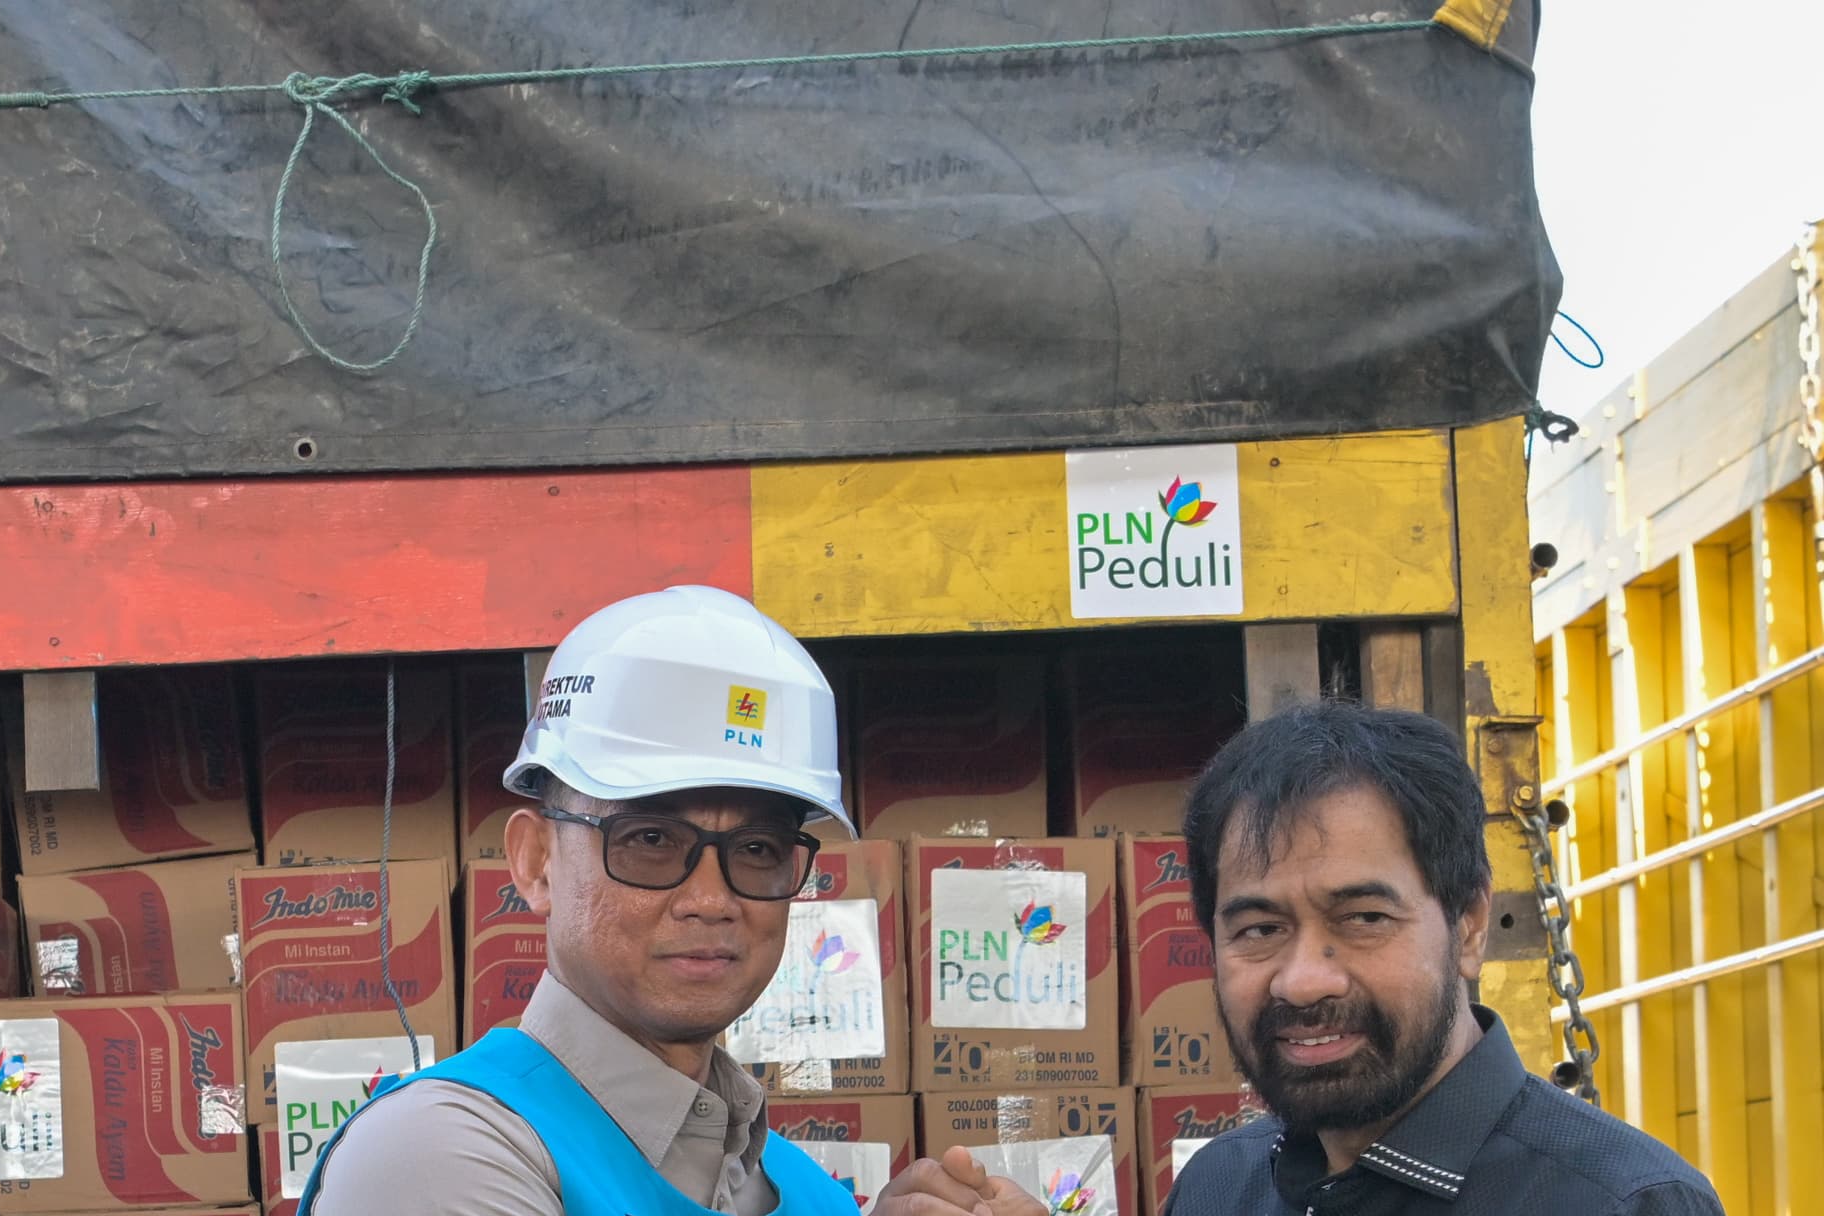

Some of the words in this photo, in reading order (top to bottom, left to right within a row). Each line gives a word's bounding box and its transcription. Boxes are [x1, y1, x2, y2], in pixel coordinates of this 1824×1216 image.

[1077, 512, 1152, 545] PLN
[1078, 541, 1231, 589] Peduli
[725, 729, 763, 748] PLN
[1175, 907, 1193, 922] Mi
[285, 946, 302, 959] Mi
[306, 944, 351, 957] Instan
[514, 940, 530, 953] Mi
[939, 929, 1008, 961] PLN
[938, 960, 1076, 1004] Peduli
[150, 1047, 164, 1064] Mi
[933, 1041, 991, 1075] 40
[1060, 1052, 1072, 1064] RI
[1076, 1051, 1094, 1064] MD
[1153, 1033, 1210, 1067] 40
[103, 1038, 126, 1108] Kaldu
[1179, 1067, 1210, 1076] BKS
[150, 1067, 164, 1113] Instan
[102, 1112, 127, 1181] Ayam
